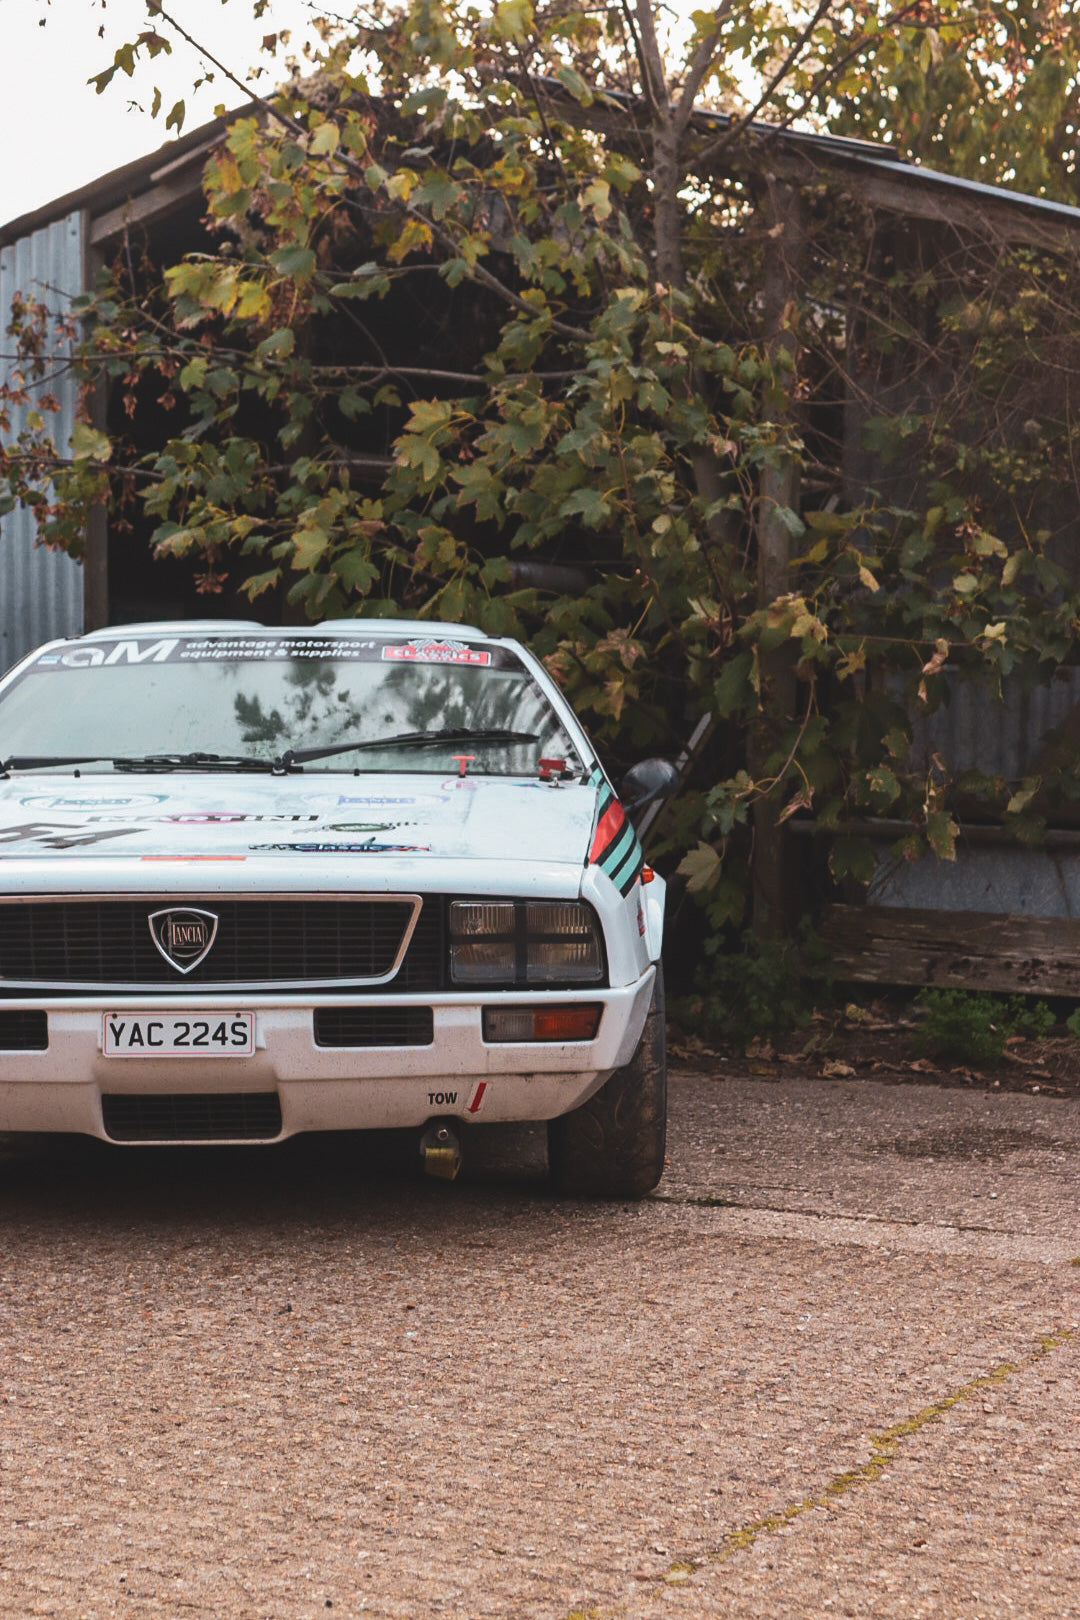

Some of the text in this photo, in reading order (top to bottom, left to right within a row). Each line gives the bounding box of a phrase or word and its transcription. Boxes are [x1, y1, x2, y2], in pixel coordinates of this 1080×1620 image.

[186, 640, 377, 649] advantage motorsport
[180, 648, 361, 659] equipment & supplies
[90, 815, 318, 823] MARTINI
[172, 923, 203, 946] LANCIA
[109, 1021, 248, 1047] YAC 224S
[427, 1092, 458, 1105] TOW
